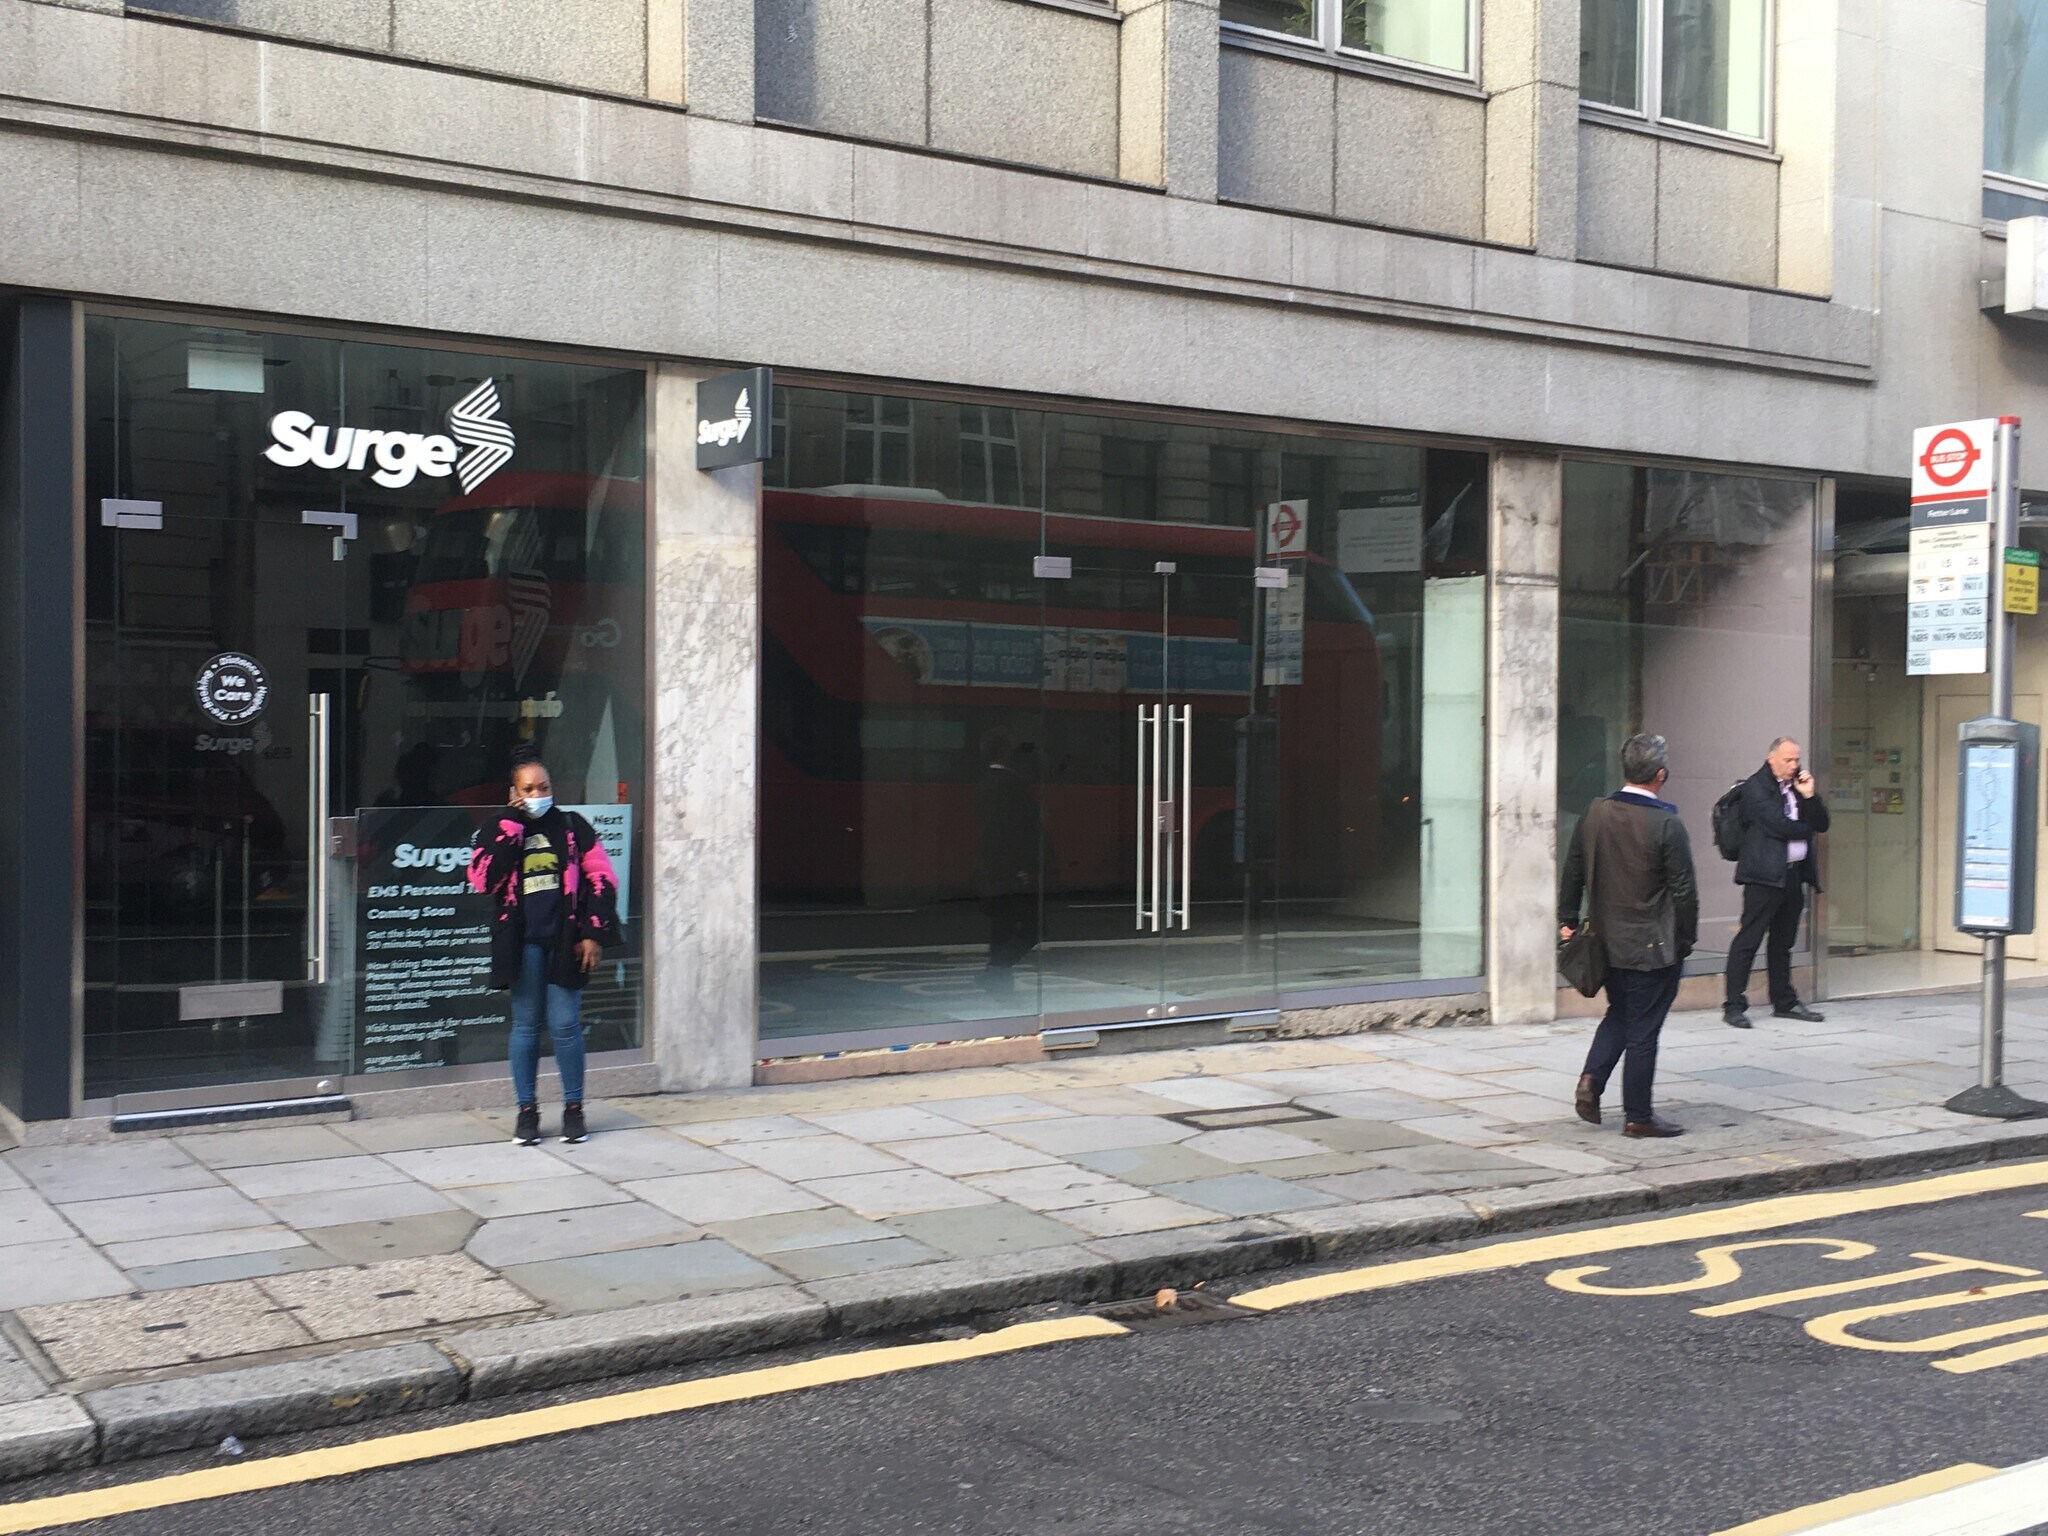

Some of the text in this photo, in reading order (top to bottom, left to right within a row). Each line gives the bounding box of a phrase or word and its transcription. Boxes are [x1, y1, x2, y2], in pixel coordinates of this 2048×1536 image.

[698, 418, 738, 448] Surge
[264, 410, 458, 489] Surge
[1951, 507, 1970, 516] Lane
[221, 675, 246, 688] We
[214, 689, 252, 701] Care
[195, 734, 253, 755] Surge
[594, 815, 624, 825] Next
[391, 843, 474, 873] Surge
[367, 885, 399, 898] EMS
[400, 881, 465, 897] Personal
[367, 906, 456, 920] Coming Soon
[367, 924, 490, 939] Get the body you want in
[365, 941, 381, 950] 20
[381, 939, 424, 949] minutes,
[424, 938, 450, 947] once
[449, 938, 468, 947] per
[365, 962, 390, 970] Now
[390, 959, 420, 970] hiring
[421, 956, 454, 967] Studio
[365, 970, 411, 981] Personal
[411, 967, 451, 978] Trainers
[451, 965, 472, 975] and
[431, 977, 472, 987] contact
[365, 1004, 392, 1013] more
[365, 1014, 505, 1033] Visit surge.co.uk for exclusive
[364, 1031, 426, 1046] pre-opening
[364, 1051, 423, 1065] surge.co.uk
